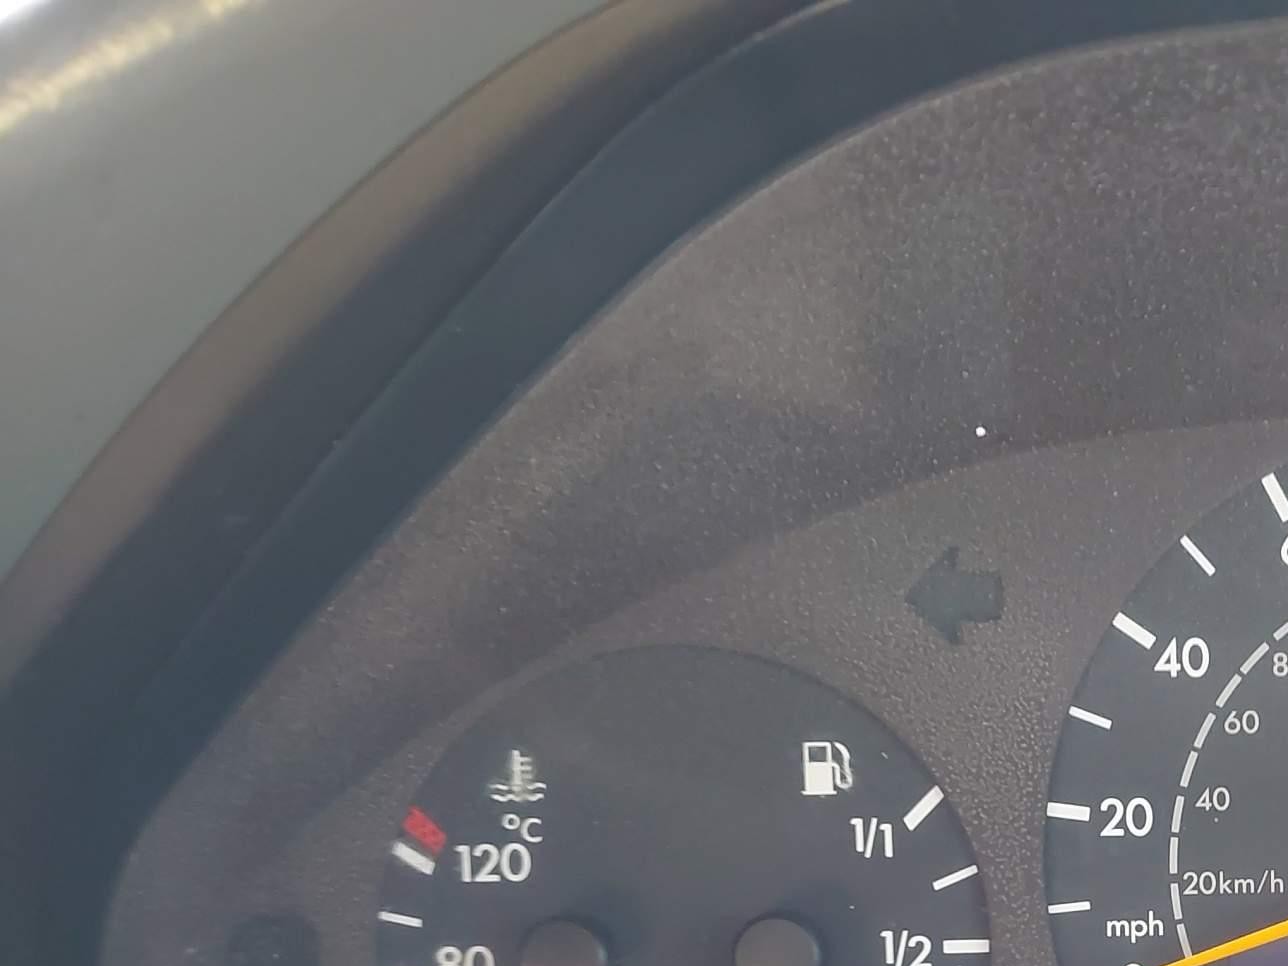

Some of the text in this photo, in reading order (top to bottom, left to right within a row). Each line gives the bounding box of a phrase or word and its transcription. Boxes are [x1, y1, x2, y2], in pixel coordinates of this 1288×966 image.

[1154, 638, 1209, 677] 40
[1223, 709, 1259, 734] 60
[1196, 788, 1229, 810] 40
[1101, 798, 1153, 836] 20
[456, 844, 531, 882] 120
[1107, 911, 1163, 943] mph
